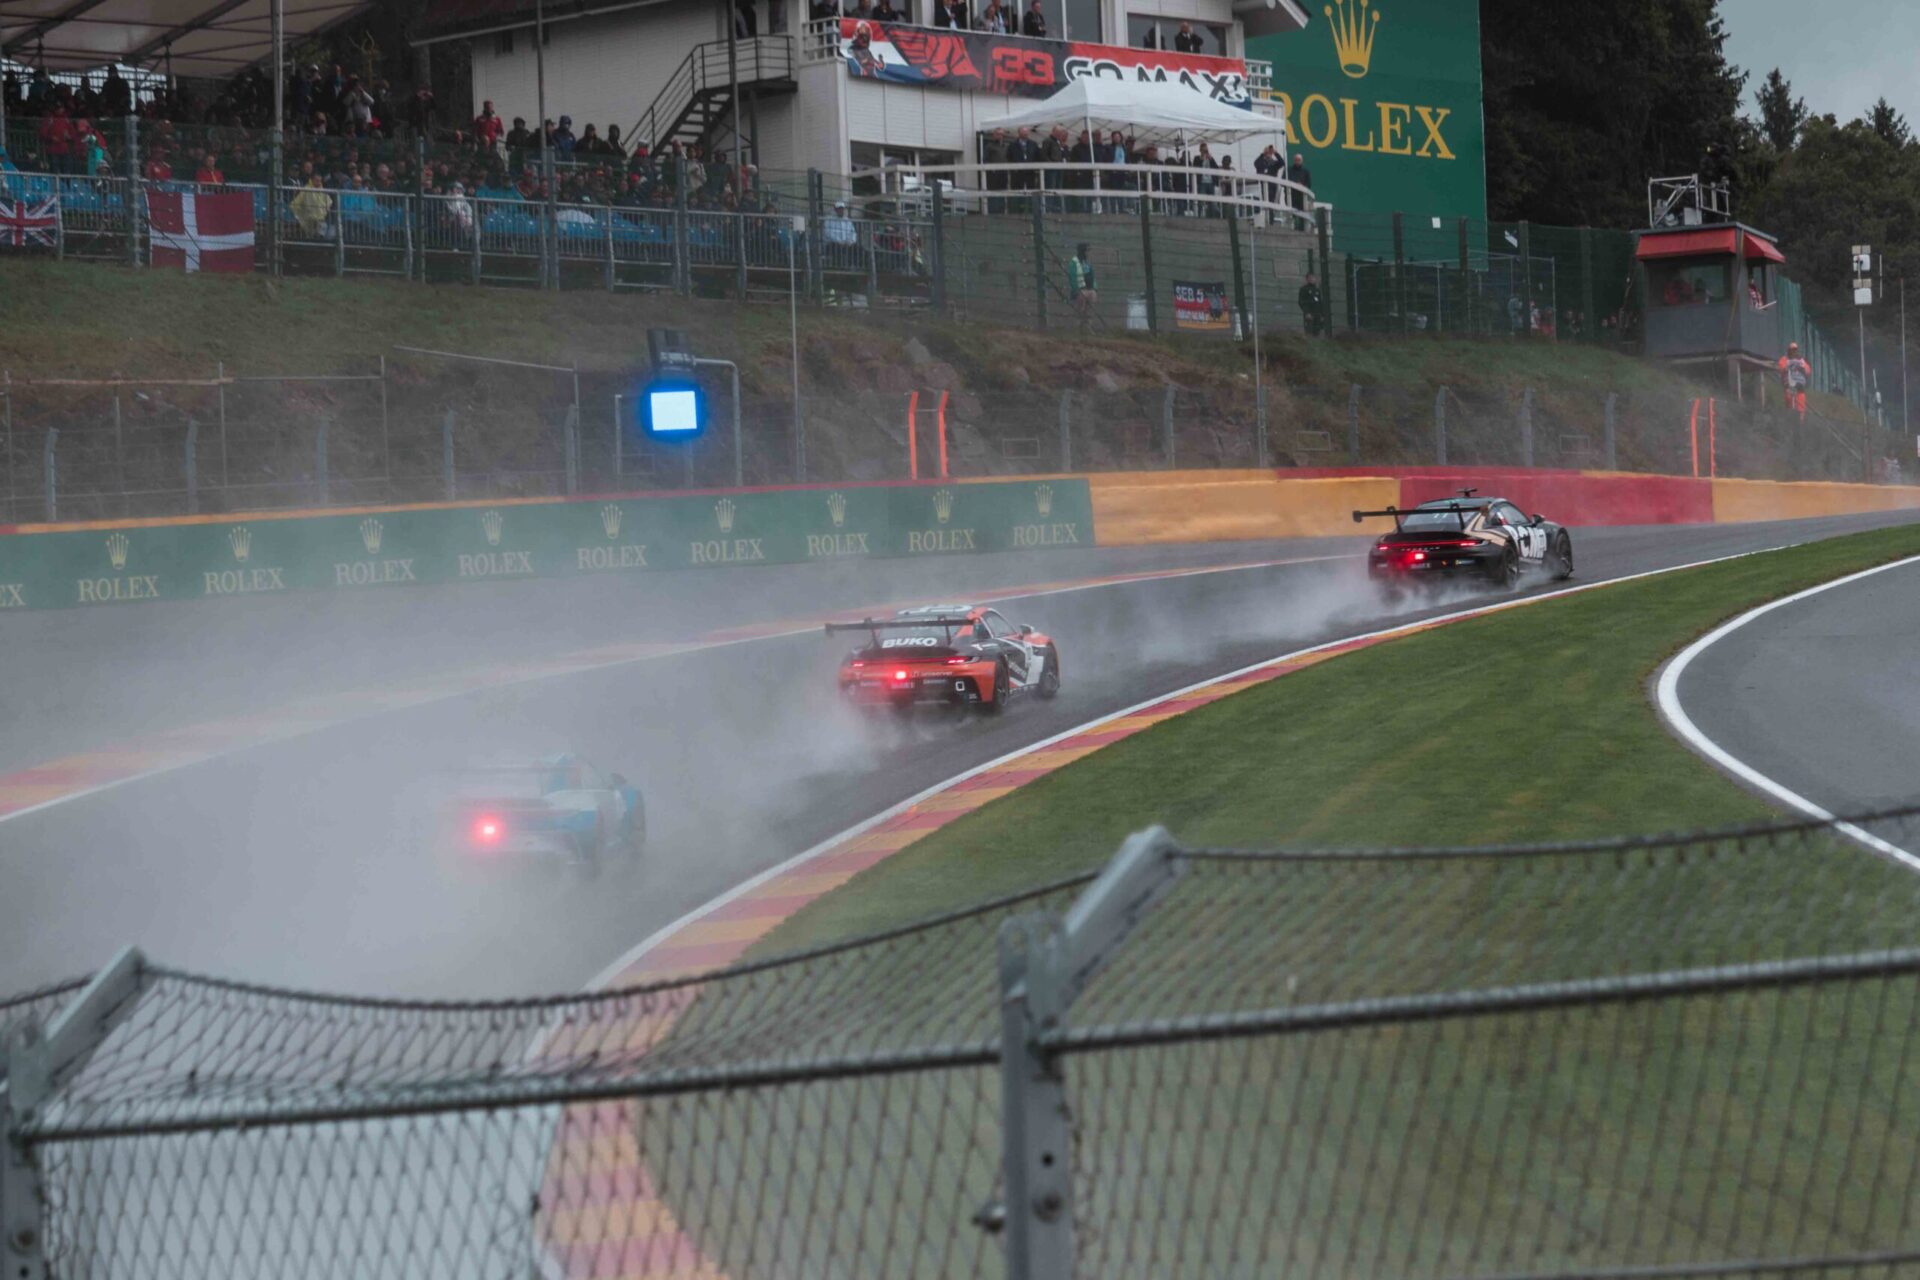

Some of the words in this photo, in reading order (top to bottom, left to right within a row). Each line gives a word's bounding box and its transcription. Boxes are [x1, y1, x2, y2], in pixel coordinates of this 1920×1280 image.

[991, 47, 1055, 85] 33
[1260, 91, 1456, 160] ROLEX
[806, 532, 870, 557] ROLEX
[908, 528, 977, 552] ROLEX
[1012, 522, 1079, 547] ROLEX
[458, 551, 535, 577] ROLEX
[577, 544, 648, 570] ROLEX
[690, 538, 766, 564] ROLEX
[203, 567, 286, 595] ROLEX
[333, 558, 417, 586] ROLEX
[78, 575, 160, 602] ROLEX
[882, 637, 938, 649] BUKO
